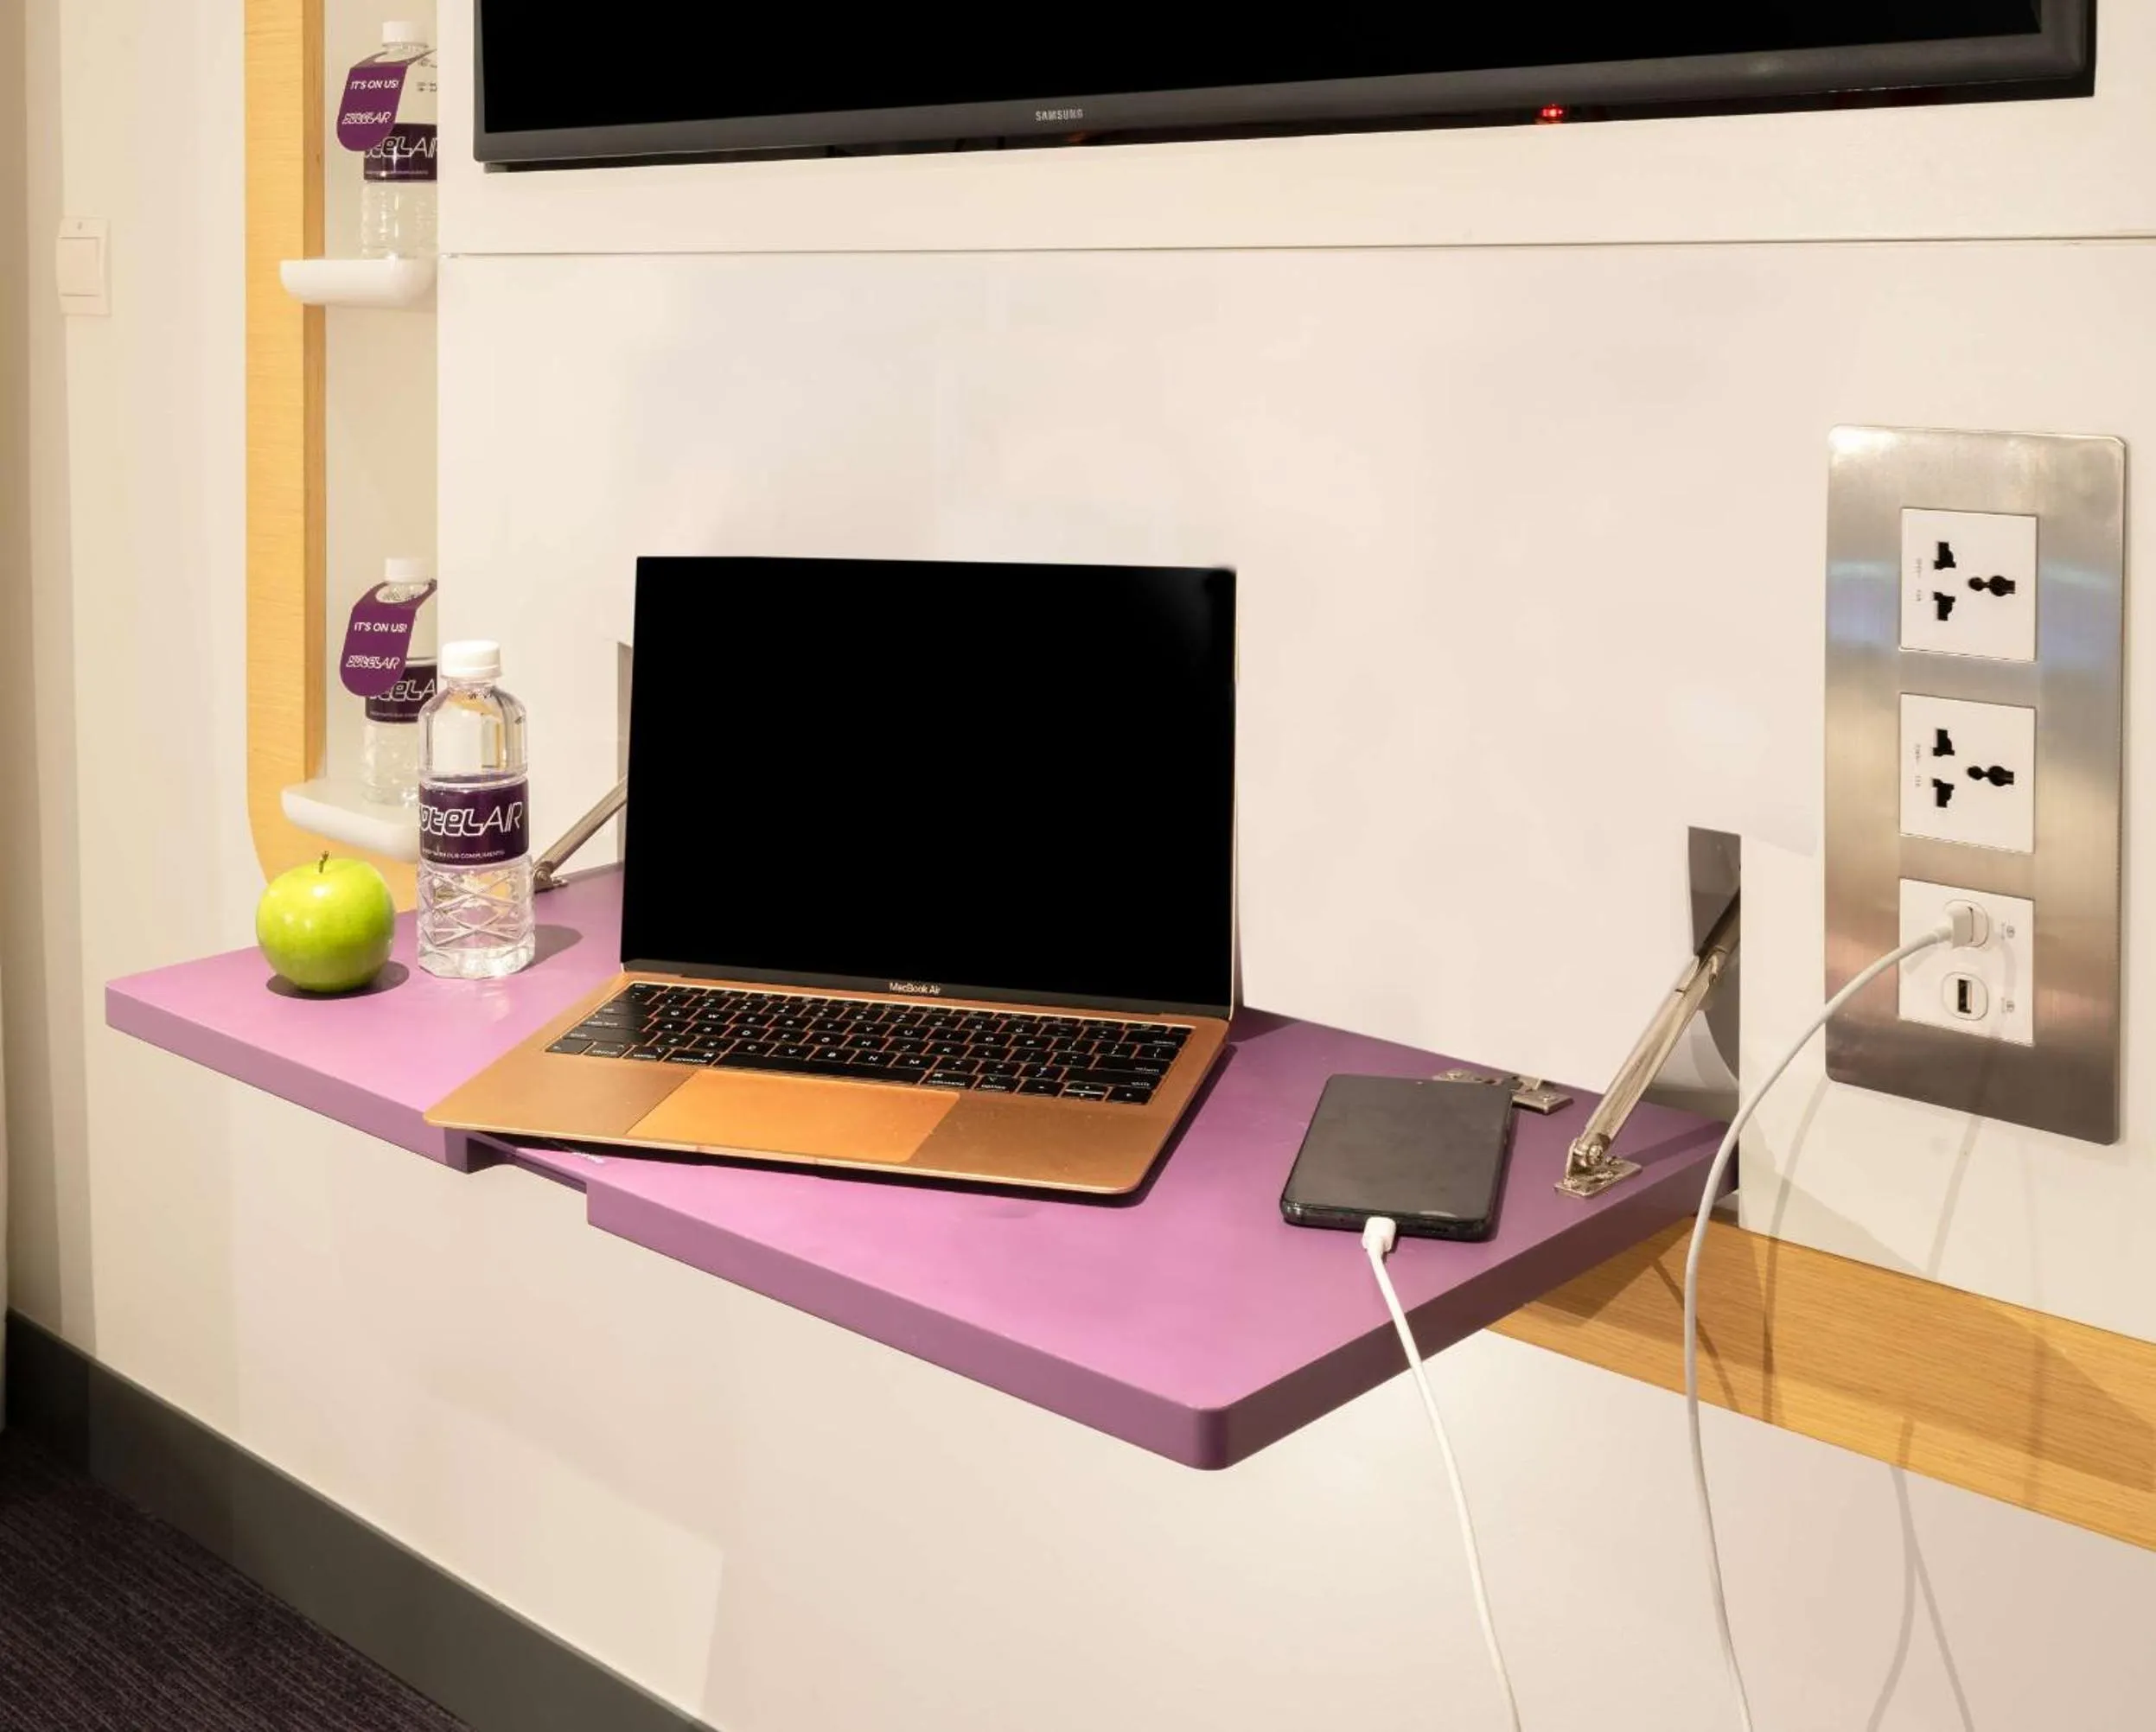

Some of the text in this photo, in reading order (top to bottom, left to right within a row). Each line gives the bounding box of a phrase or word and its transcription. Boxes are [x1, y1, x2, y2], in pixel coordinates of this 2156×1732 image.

[350, 79, 400, 90] IT'S ON US!
[1036, 108, 1083, 121] SAMSUNG
[354, 621, 408, 634] IT'S ON US!
[889, 981, 941, 995] MacBook Air
